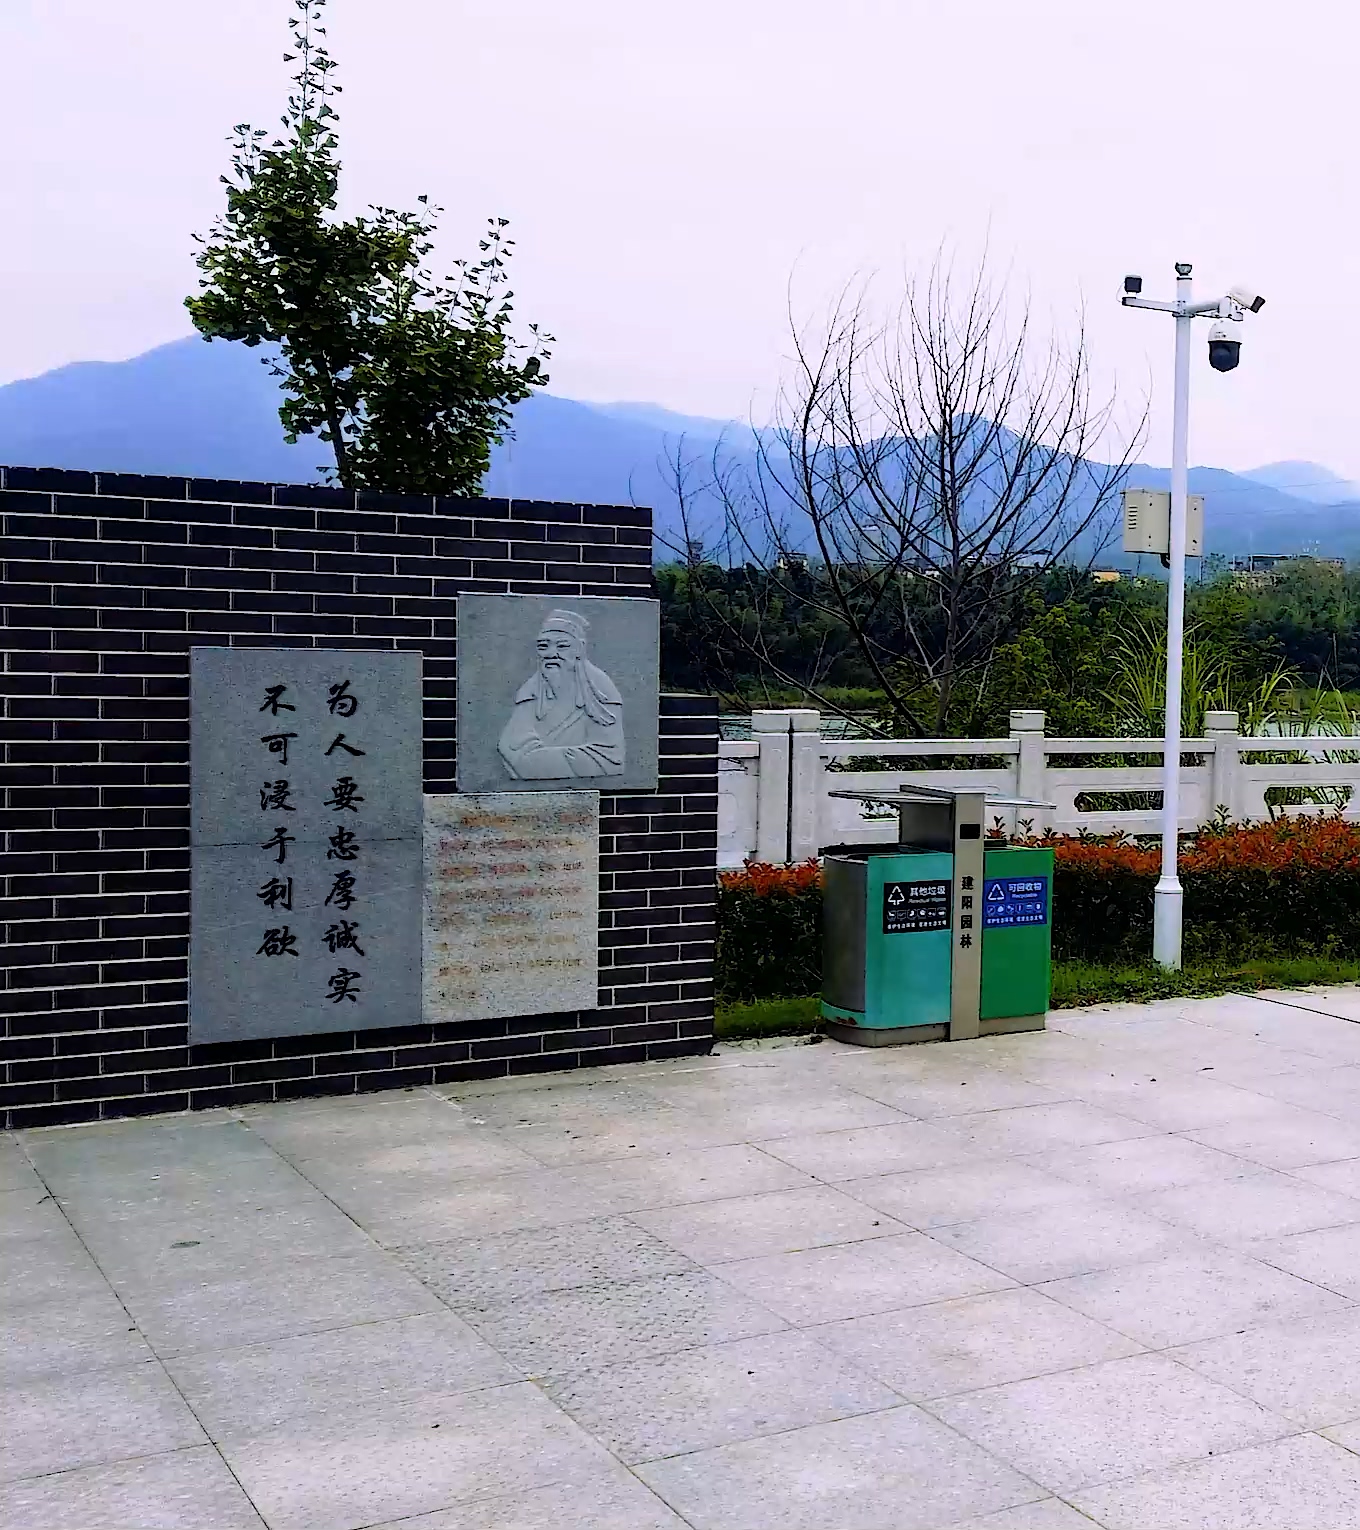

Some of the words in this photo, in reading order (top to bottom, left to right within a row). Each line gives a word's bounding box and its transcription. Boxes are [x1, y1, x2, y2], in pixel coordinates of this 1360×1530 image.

[256, 684, 300, 958] 不可浸于利欲
[323, 680, 366, 1004] 为人要忠厚诚实
[909, 885, 946, 897] 其他垃圾
[959, 876, 975, 949] 建阳园林
[1008, 882, 1042, 892] 可回收物
